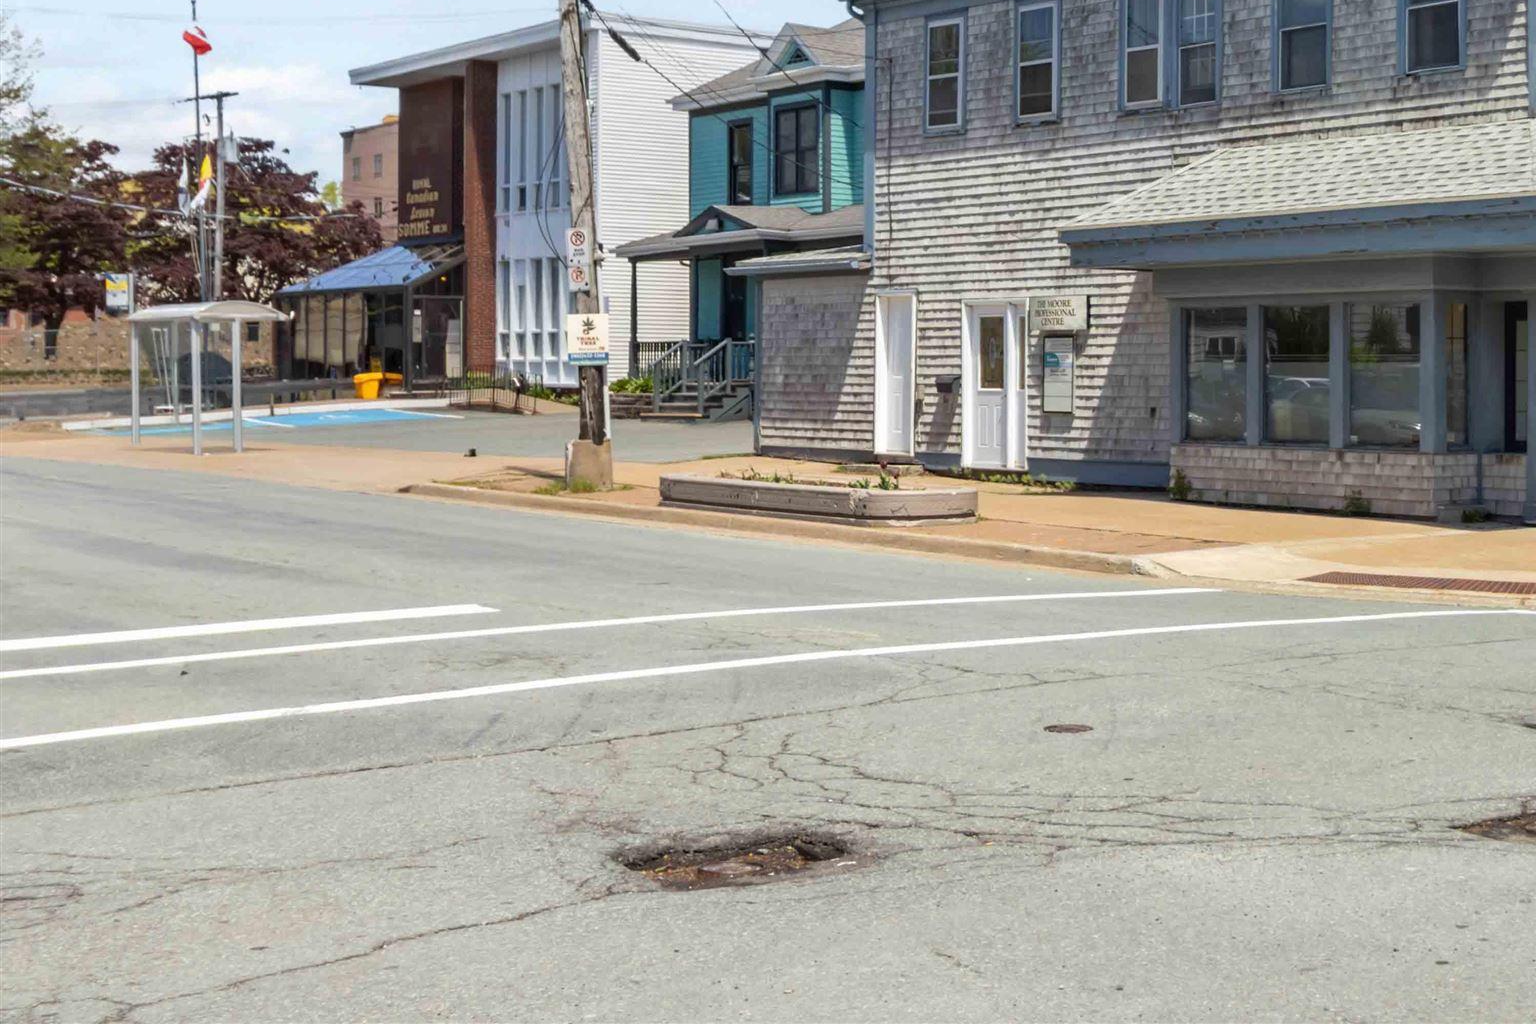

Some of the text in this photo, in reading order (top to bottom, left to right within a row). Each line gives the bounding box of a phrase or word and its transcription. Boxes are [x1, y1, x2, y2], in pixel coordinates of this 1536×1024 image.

[1047, 299, 1072, 307] MOORE
[1034, 308, 1077, 317] PROFESSIONAL
[1041, 317, 1065, 326] CENTRE
